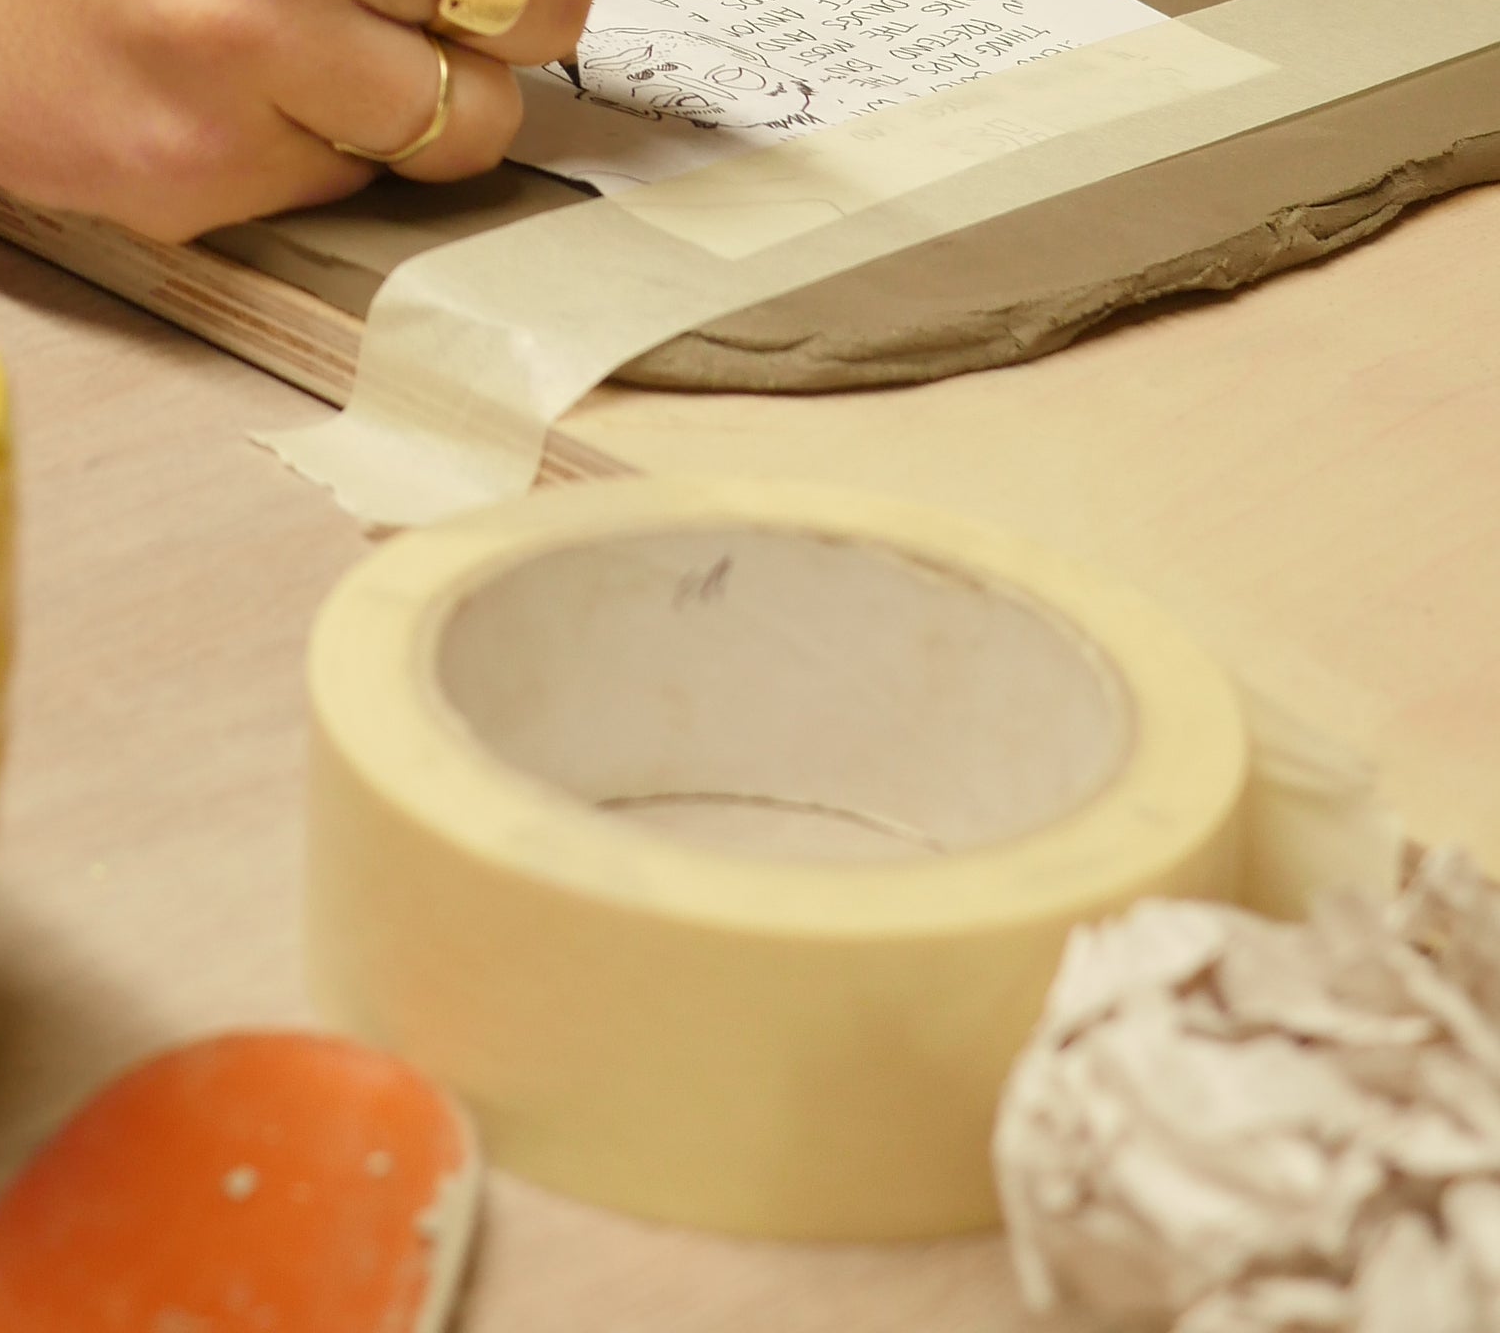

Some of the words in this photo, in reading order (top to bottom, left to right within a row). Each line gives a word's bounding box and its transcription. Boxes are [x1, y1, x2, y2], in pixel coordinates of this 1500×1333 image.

[755, 28, 818, 53] AND
[857, 20, 920, 43] THE
[888, 17, 1004, 61] PRETEND
[974, 24, 1052, 58] THING
[788, 37, 857, 68] MOST
[911, 49, 981, 76] RIPS
[847, 66, 909, 90] THE
